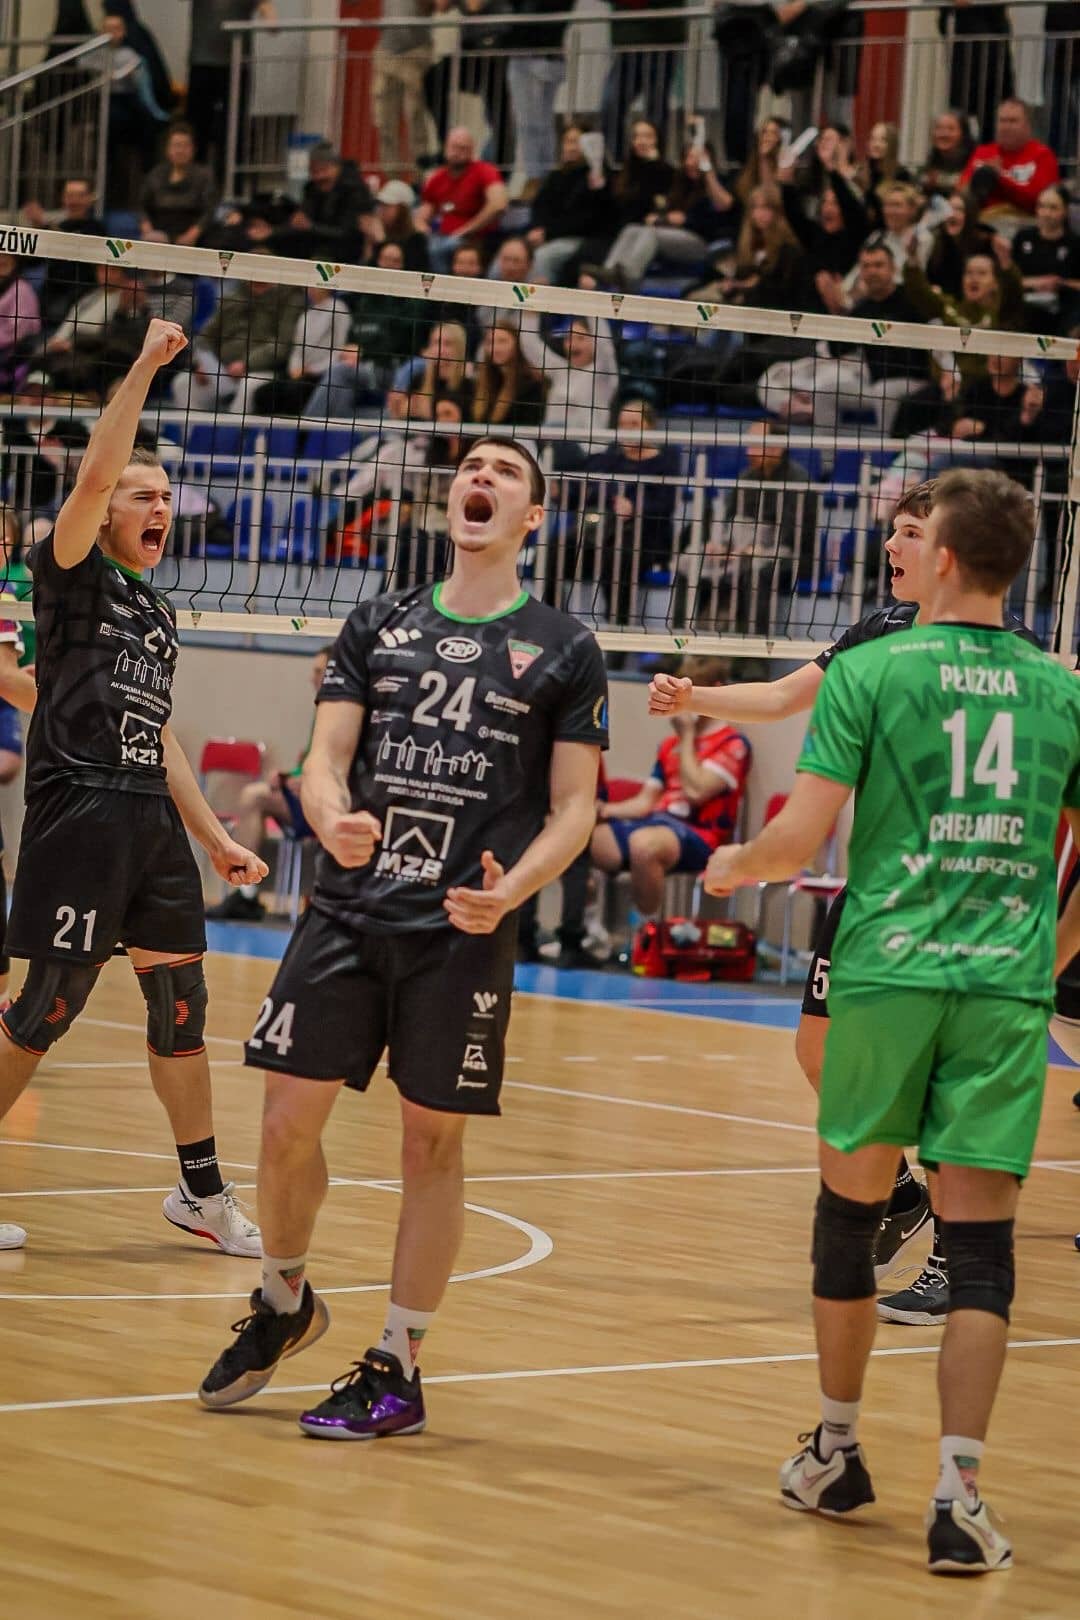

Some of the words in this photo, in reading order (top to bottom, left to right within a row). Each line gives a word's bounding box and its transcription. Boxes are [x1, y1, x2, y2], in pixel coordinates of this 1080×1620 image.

[412, 670, 476, 732] 24
[939, 663, 1018, 697] PŁUŻKA
[942, 708, 1019, 800] 14
[929, 813, 1024, 846] CHEŁMIEC
[376, 851, 443, 880] MZB
[53, 905, 97, 951] 21
[812, 957, 831, 1000] 5
[250, 997, 296, 1056] 24
